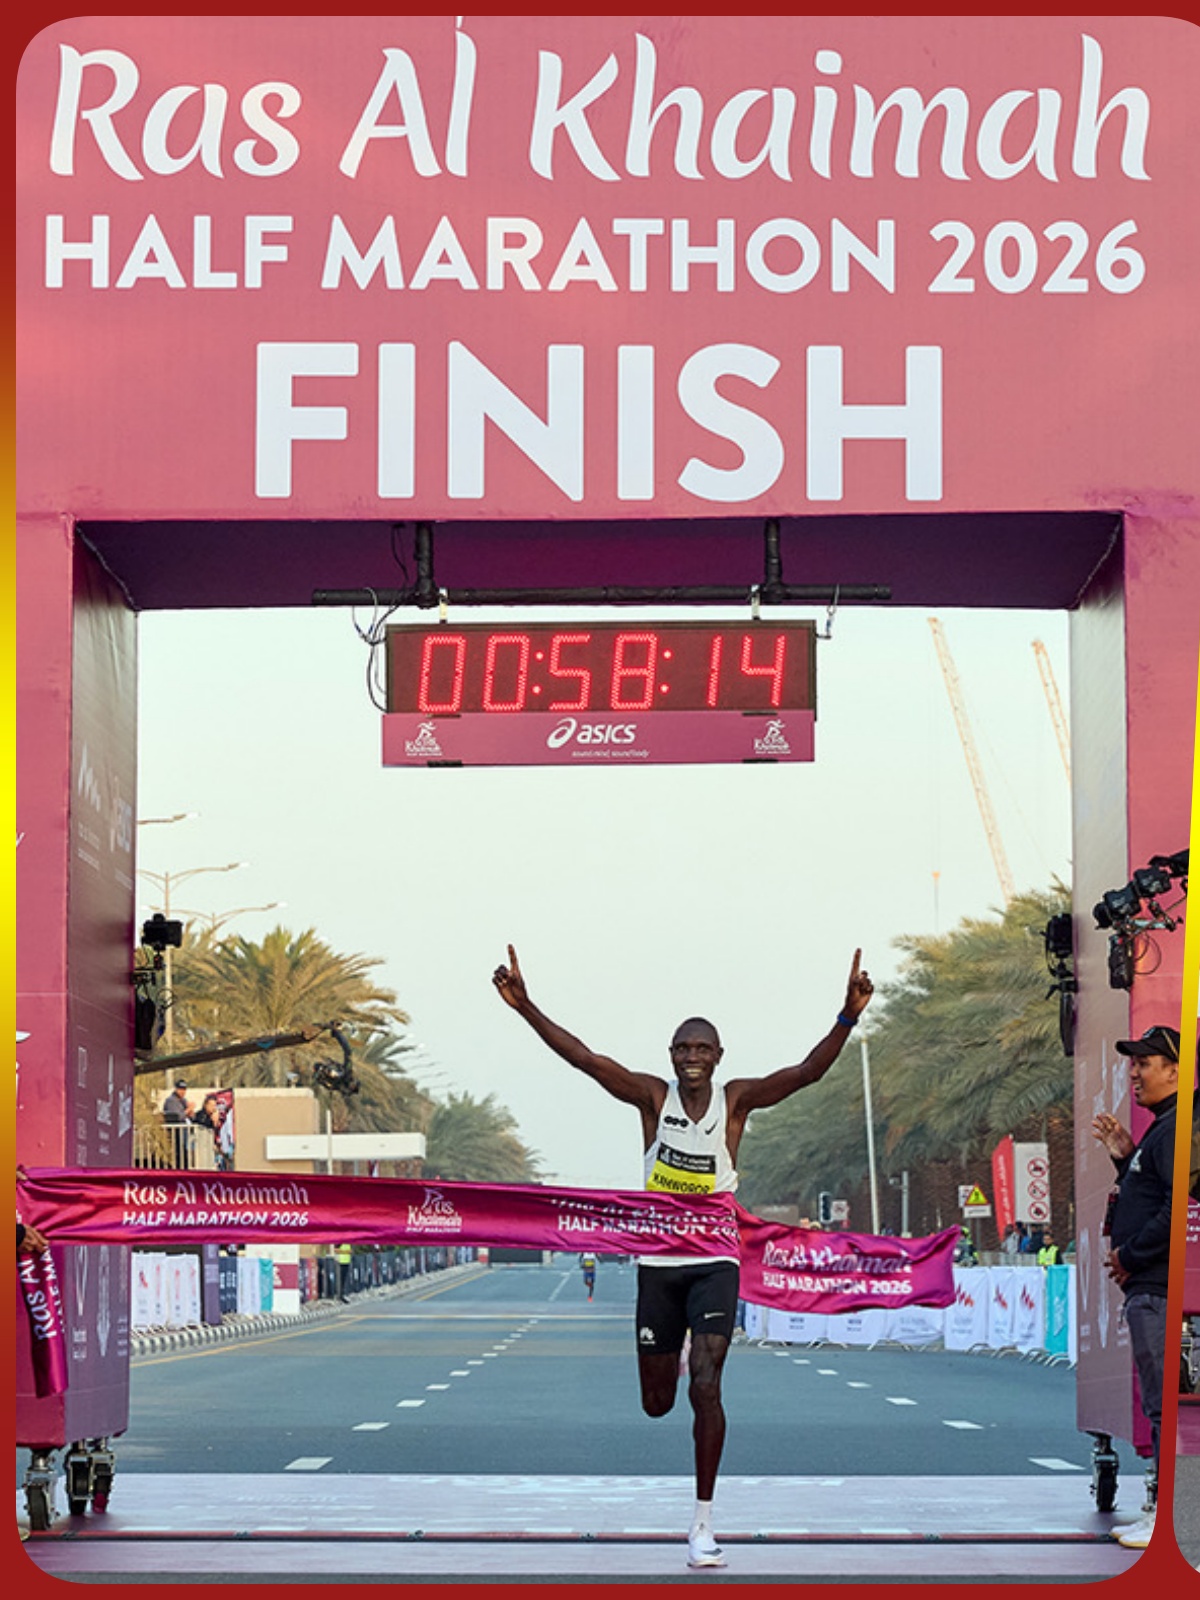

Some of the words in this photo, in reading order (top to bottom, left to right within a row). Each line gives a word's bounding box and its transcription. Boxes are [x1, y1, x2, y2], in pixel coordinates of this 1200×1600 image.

[50, 44, 301, 180] Ras
[340, 26, 476, 178] Al
[530, 33, 1151, 182] Khaimah
[46, 214, 292, 288] HALF
[322, 215, 894, 293] MARATHON
[928, 220, 1145, 293] 2026
[256, 341, 942, 502] FINISH
[418, 633, 787, 712] 00:58:14
[122, 1211, 166, 1226] HALF
[168, 1211, 268, 1226] MARATHON
[270, 1211, 309, 1226] 2026
[123, 1181, 168, 1206] Ras
[173, 1181, 196, 1205] Al
[202, 1181, 310, 1206] Khaimah
[558, 1215, 600, 1232] HALF
[869, 1280, 913, 1295] 2026
[26, 1290, 57, 1340] Ras
